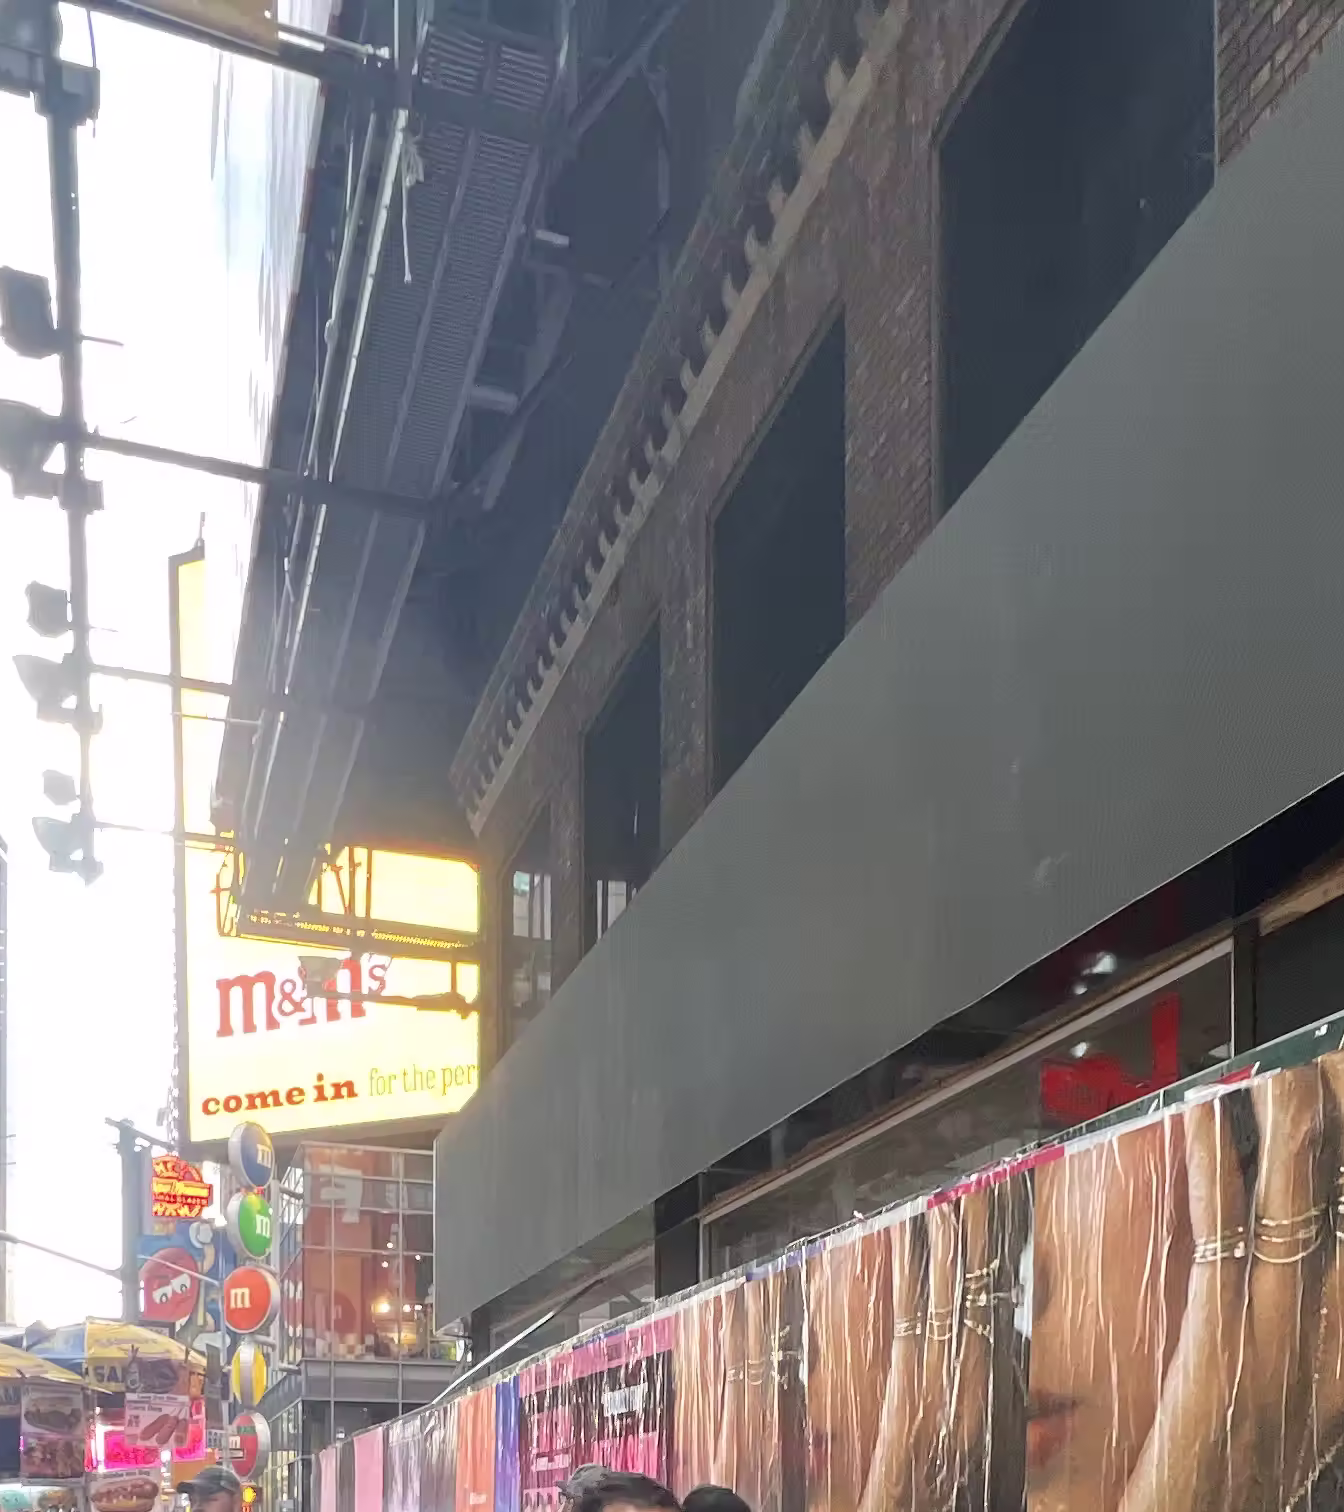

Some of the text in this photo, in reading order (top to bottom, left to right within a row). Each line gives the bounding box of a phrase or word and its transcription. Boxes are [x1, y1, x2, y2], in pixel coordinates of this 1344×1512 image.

[201, 1085, 305, 1116] come
[313, 1072, 358, 1103] in
[369, 1067, 398, 1097] for
[402, 1063, 436, 1093] the
[229, 1286, 251, 1309] m
